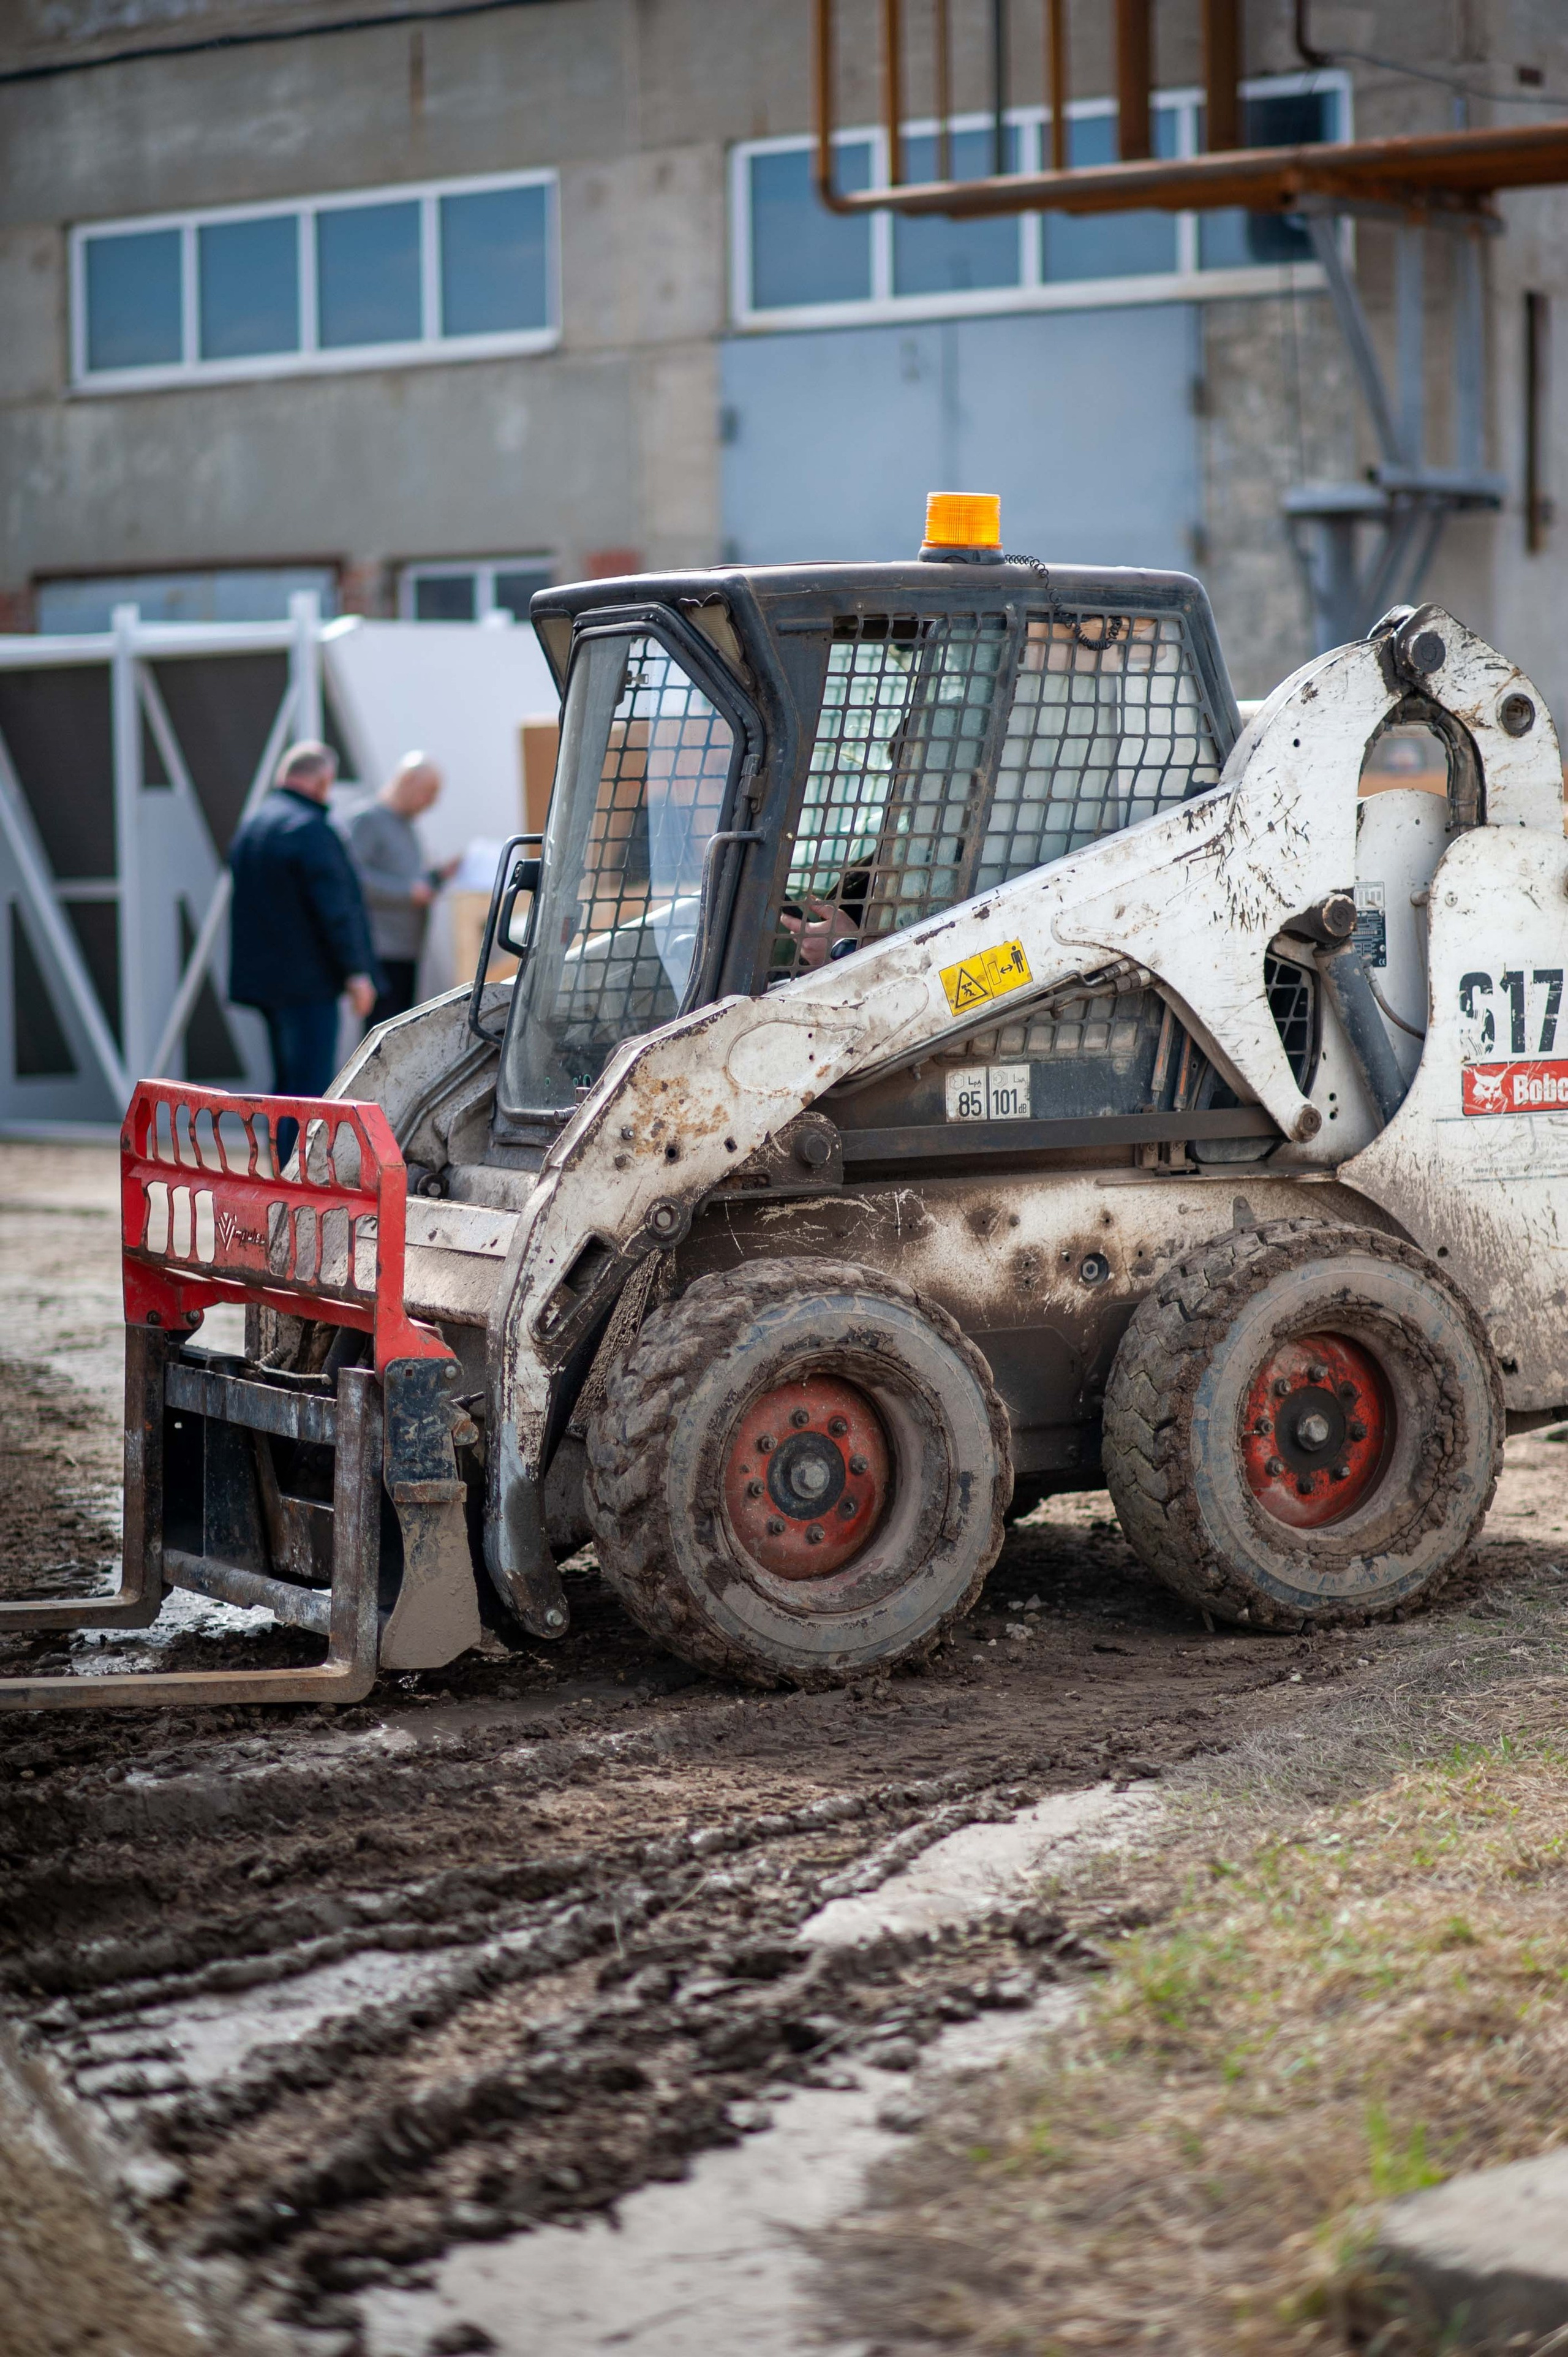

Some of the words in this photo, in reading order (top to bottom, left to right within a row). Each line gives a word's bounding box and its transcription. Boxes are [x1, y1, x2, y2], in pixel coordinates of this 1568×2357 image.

[1513, 1072, 1568, 1105] Bobc
[959, 1091, 982, 1117] 85
[992, 1089, 1017, 1115] 101
[1018, 1103, 1027, 1114] dB
